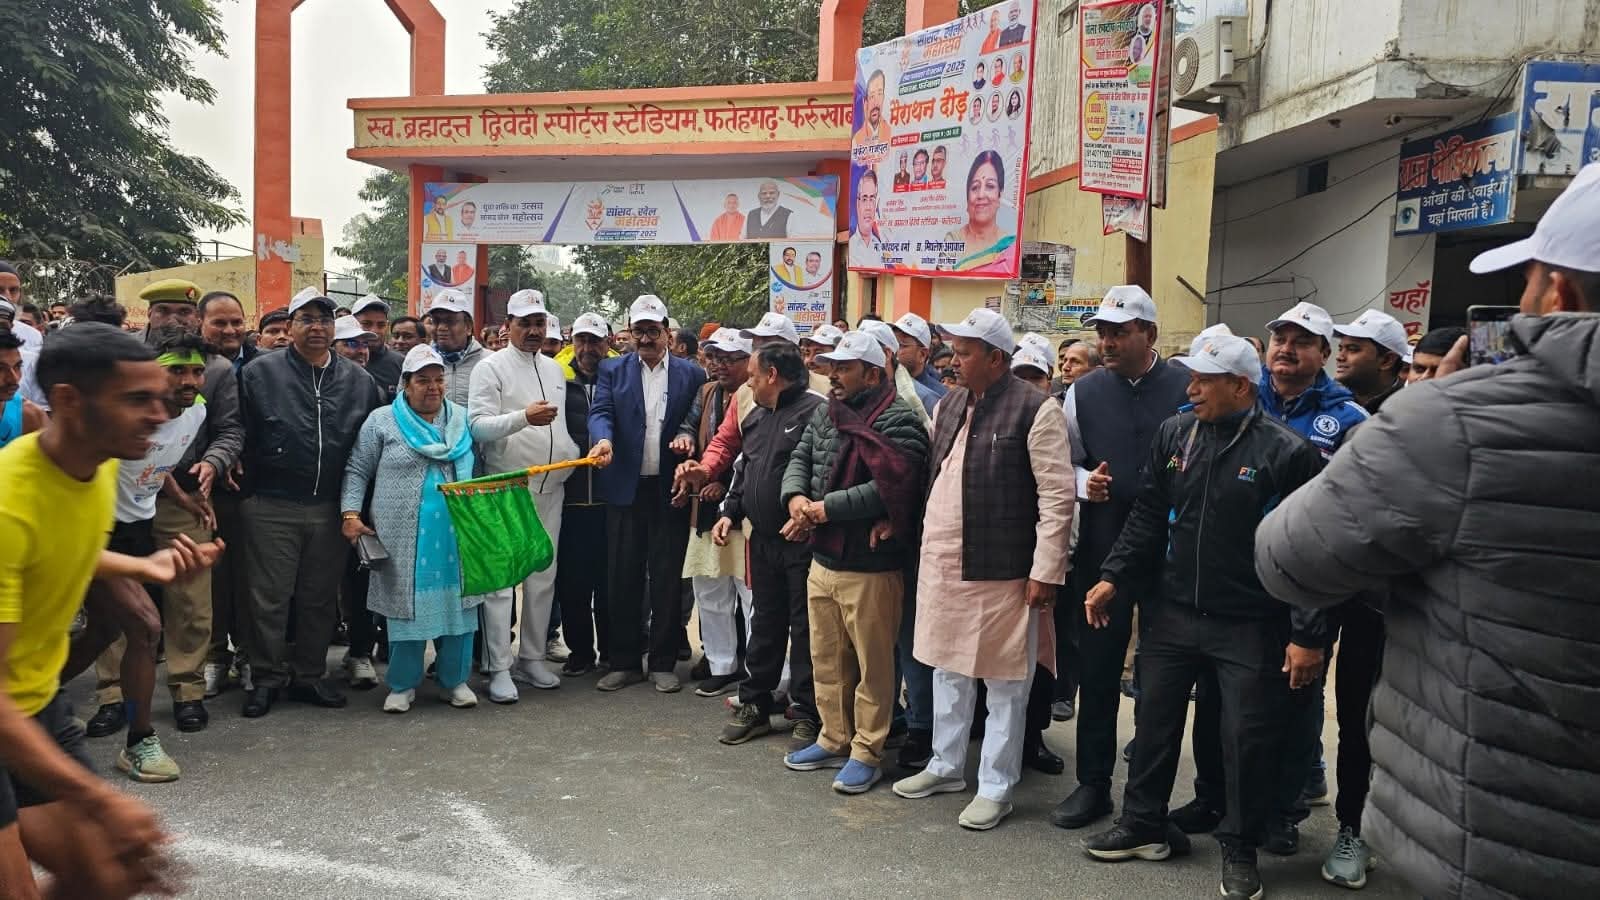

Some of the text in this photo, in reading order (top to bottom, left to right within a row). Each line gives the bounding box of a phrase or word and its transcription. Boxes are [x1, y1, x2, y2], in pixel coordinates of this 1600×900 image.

[945, 60, 966, 73] 2025
[478, 107, 538, 142] द्विवेदी
[1451, 185, 1466, 202] की
[520, 202, 544, 210] उत्सव
[606, 205, 658, 216] सांसद खेल
[511, 211, 544, 222] महोत्सव
[1447, 202, 1480, 223] मिलती
[787, 300, 808, 312] सांसद
